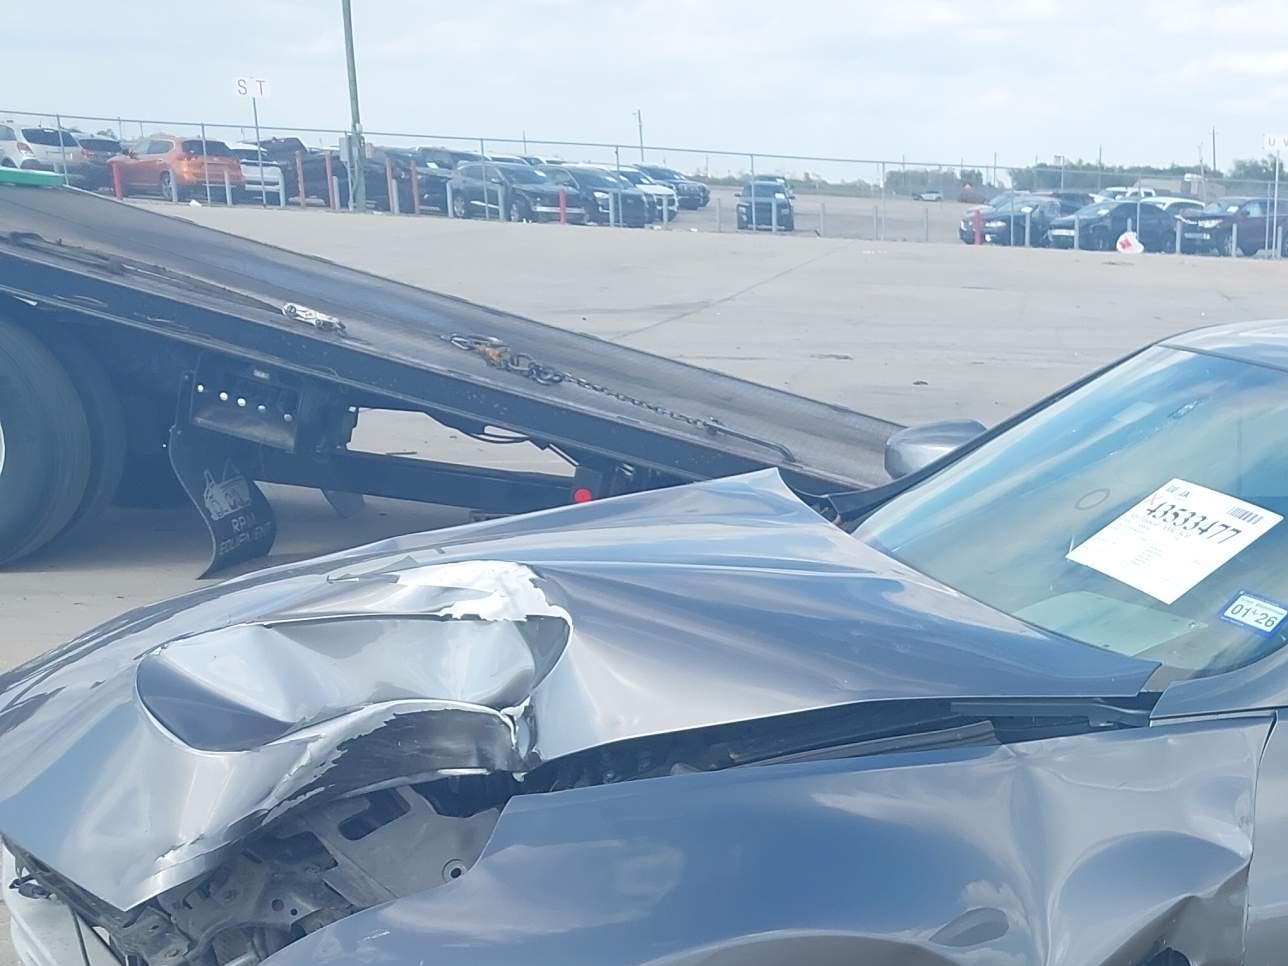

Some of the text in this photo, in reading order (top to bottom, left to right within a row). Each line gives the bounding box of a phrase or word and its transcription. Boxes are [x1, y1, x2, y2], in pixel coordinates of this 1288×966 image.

[237, 79, 265, 96] S T
[1146, 501, 1242, 545] 43533477
[1230, 603, 1252, 619] 01
[1254, 612, 1279, 628] 26
